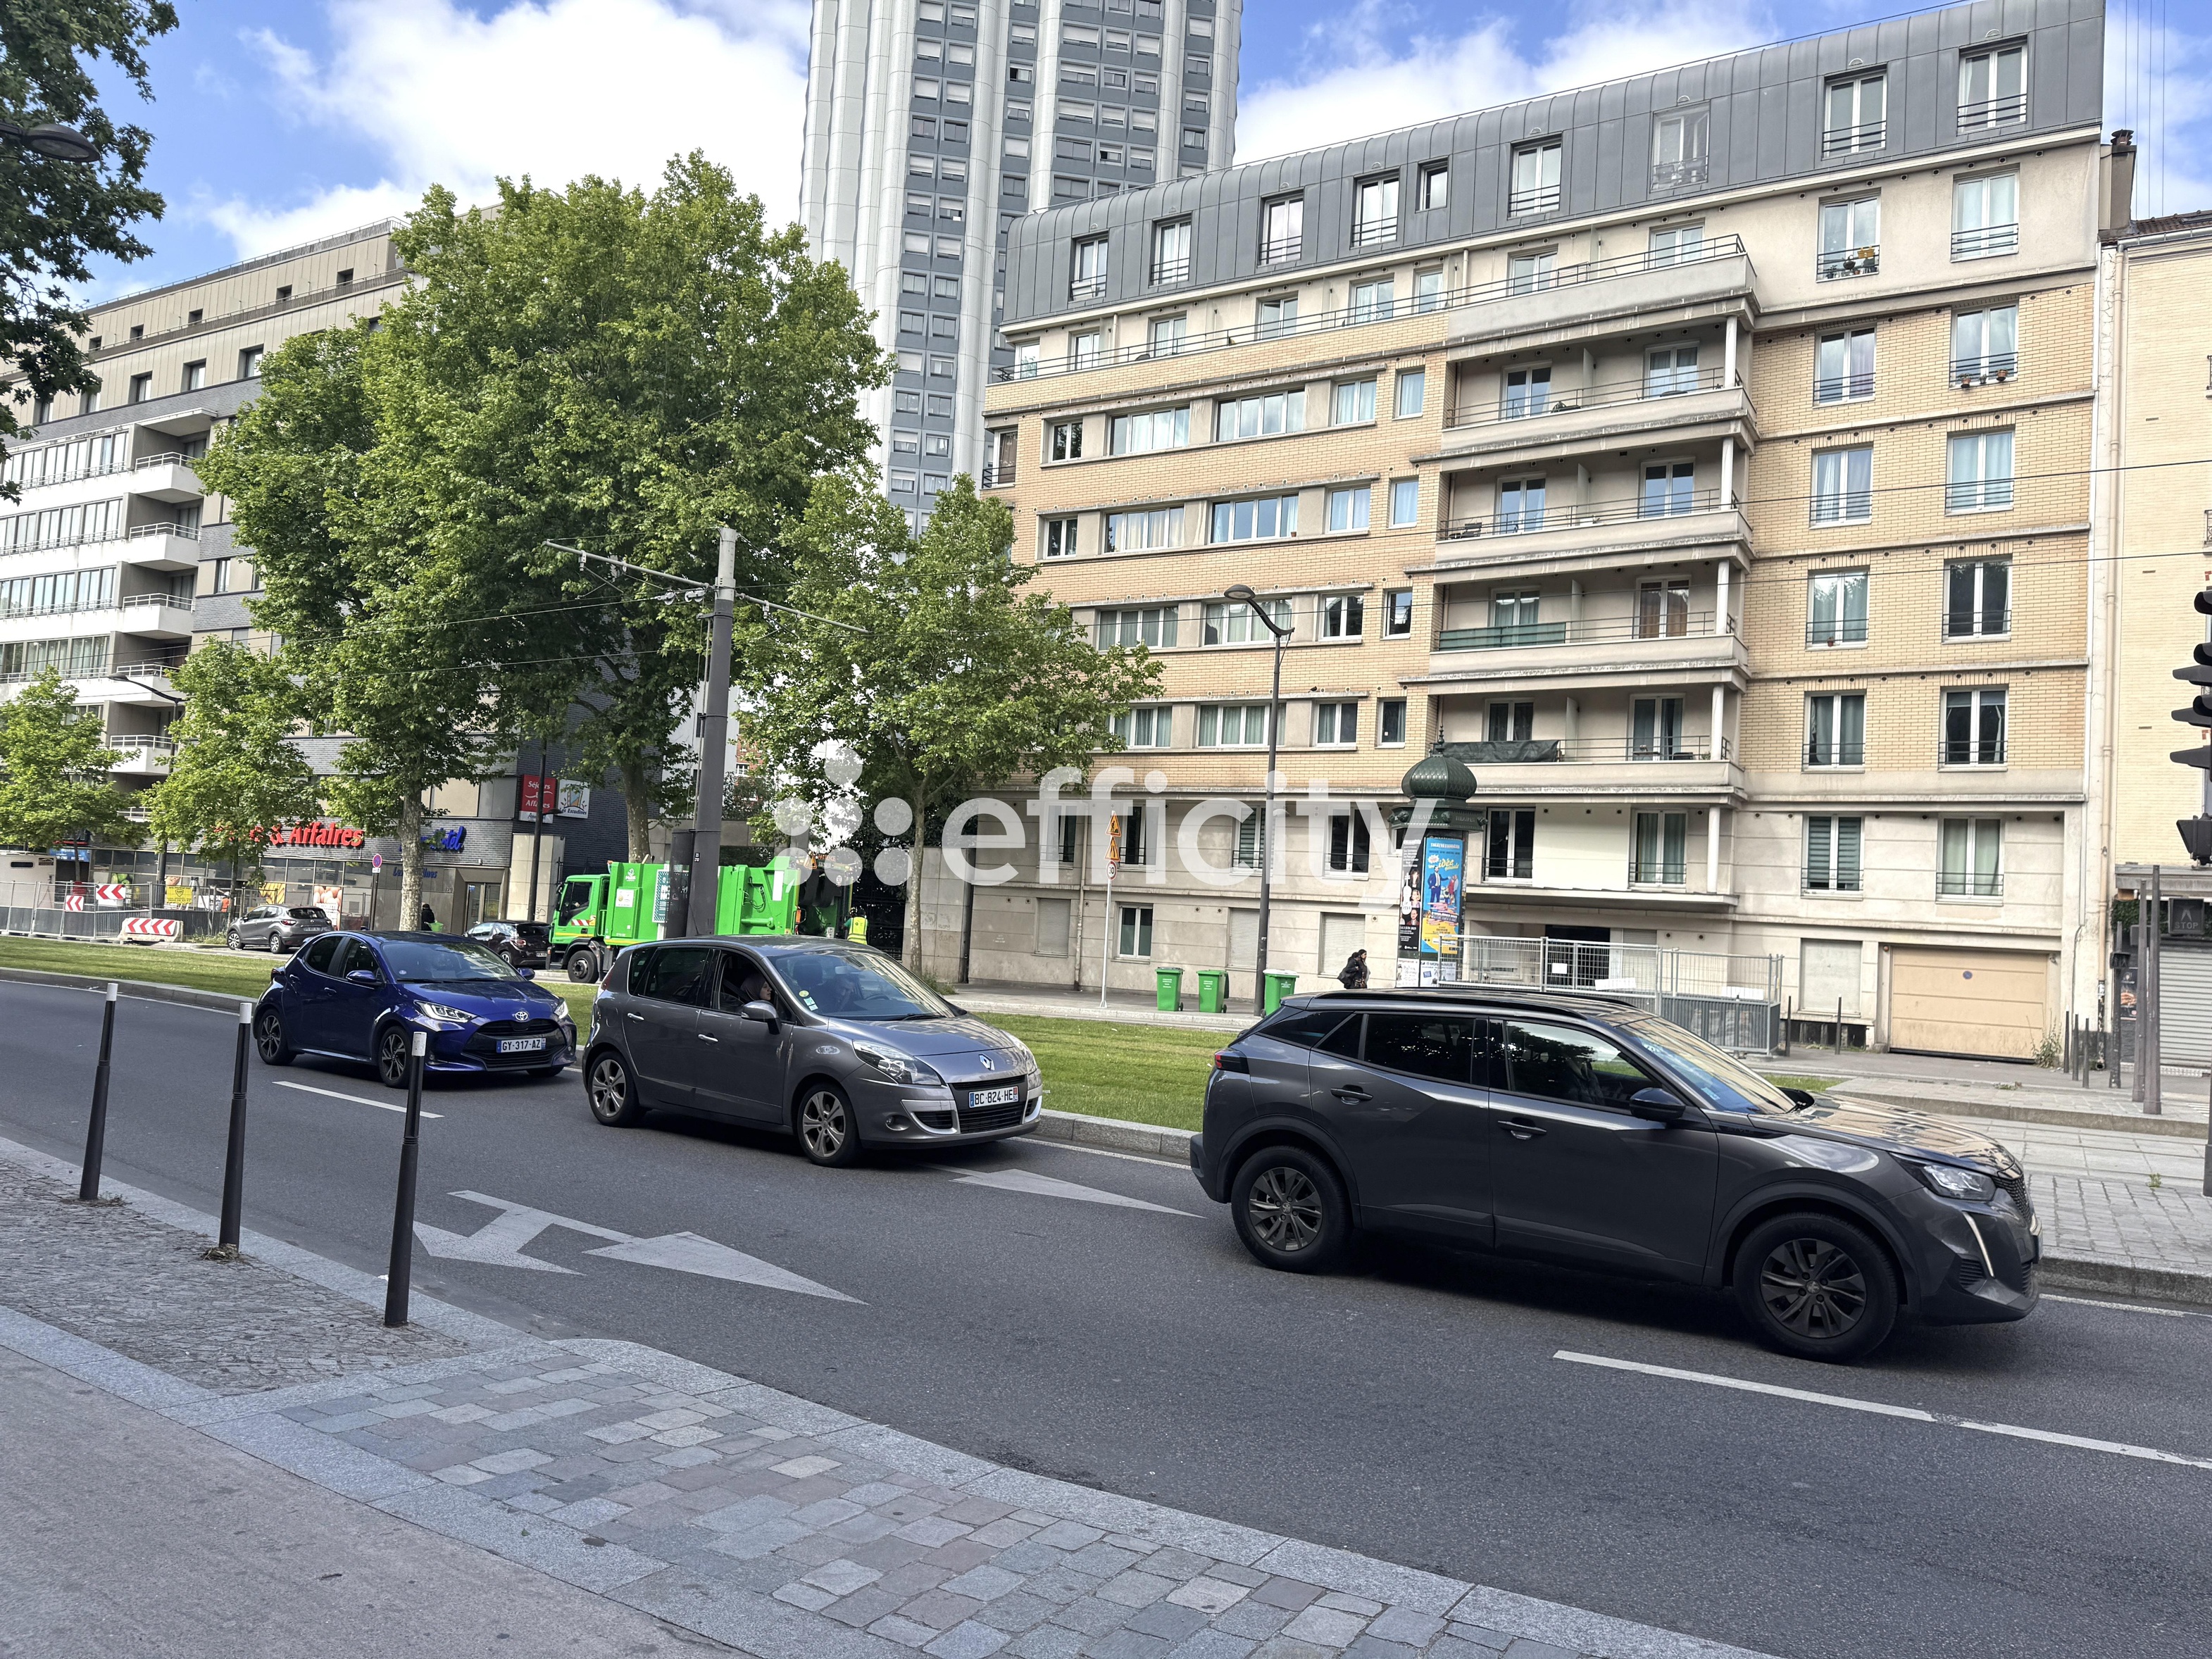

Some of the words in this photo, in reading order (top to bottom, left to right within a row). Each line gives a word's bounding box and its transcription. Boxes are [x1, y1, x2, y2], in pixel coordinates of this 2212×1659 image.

[525, 799, 551, 808] Affaes
[287, 821, 364, 846] Affaires
[502, 1039, 541, 1051] GY-317-AZ
[975, 1089, 1013, 1105] BC-824-HE
